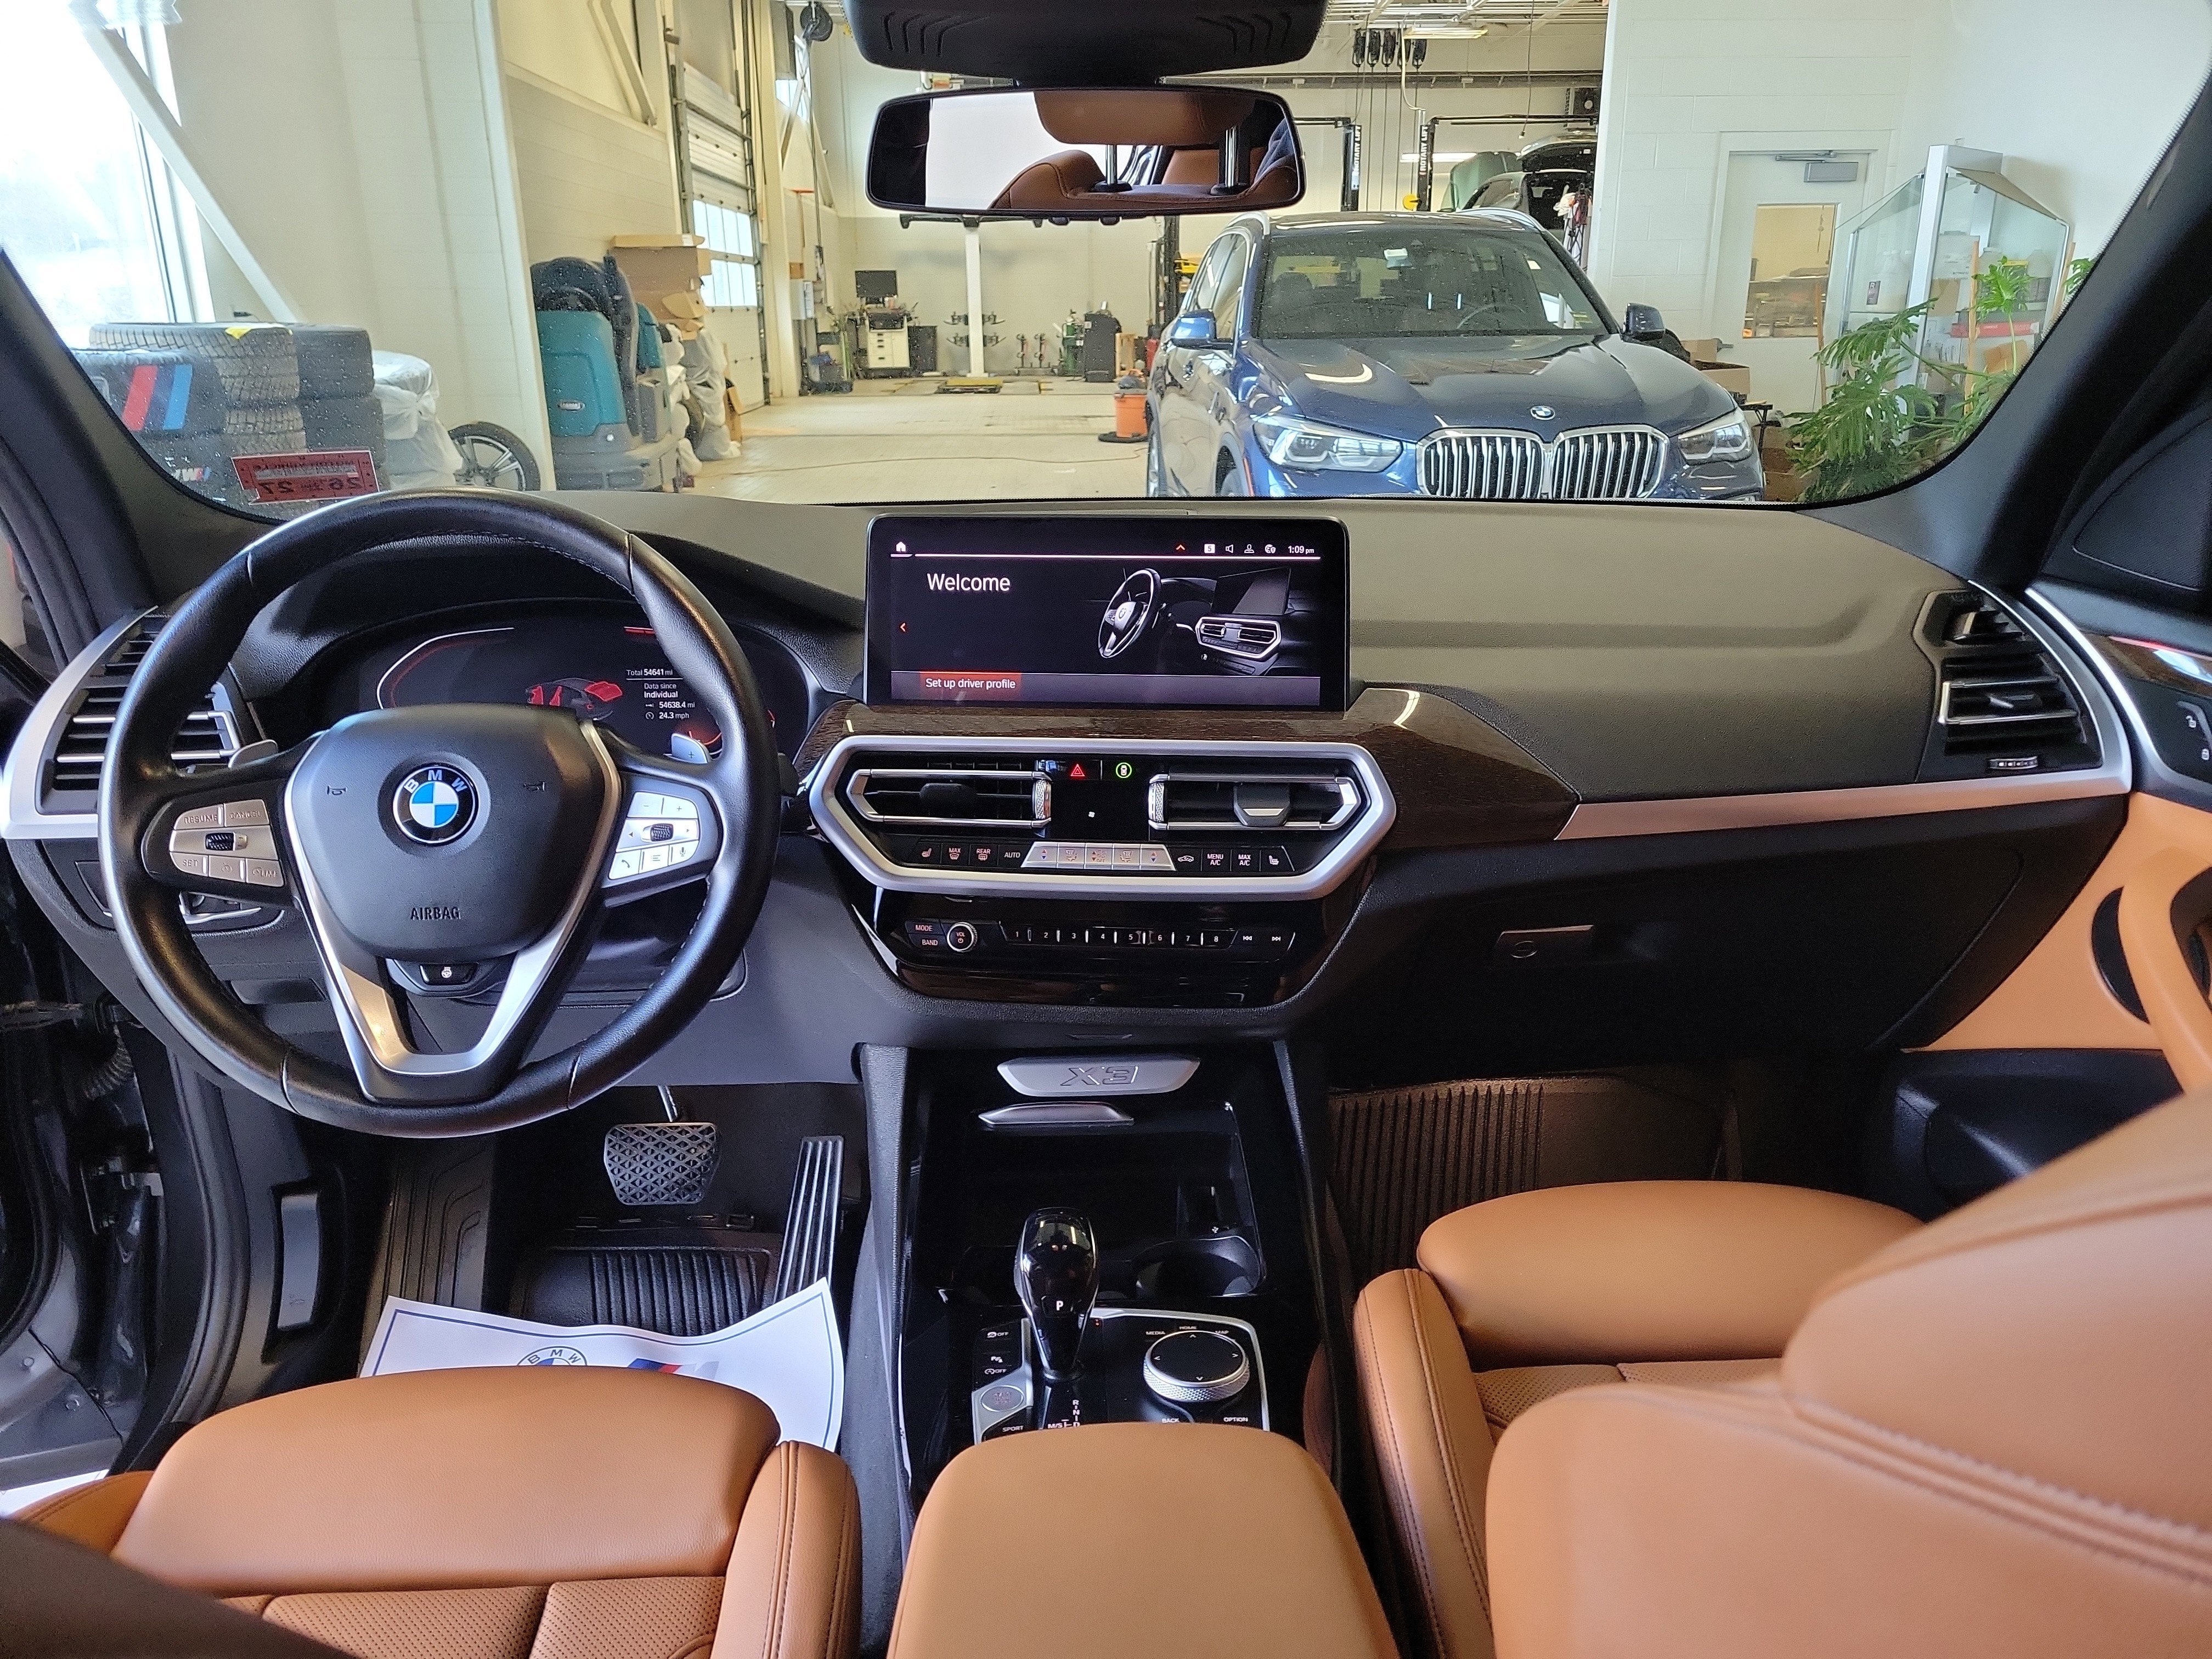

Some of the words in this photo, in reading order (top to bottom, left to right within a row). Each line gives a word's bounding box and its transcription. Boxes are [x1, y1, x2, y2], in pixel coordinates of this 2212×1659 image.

[1288, 545, 1305, 554] 1:09
[927, 573, 1011, 591] Welcome
[926, 678, 942, 688] Set
[944, 680, 956, 690] up
[958, 678, 985, 689] driver
[986, 679, 1016, 690] profile
[403, 769, 469, 794] BMW
[184, 814, 219, 824] RESUME
[229, 810, 262, 820] CANCEL
[182, 859, 199, 867] SET
[410, 907, 461, 921] AIRBAG
[1060, 1065, 1139, 1086] X3
[1056, 1300, 1064, 1311] P
[527, 1348, 582, 1364] BMW
